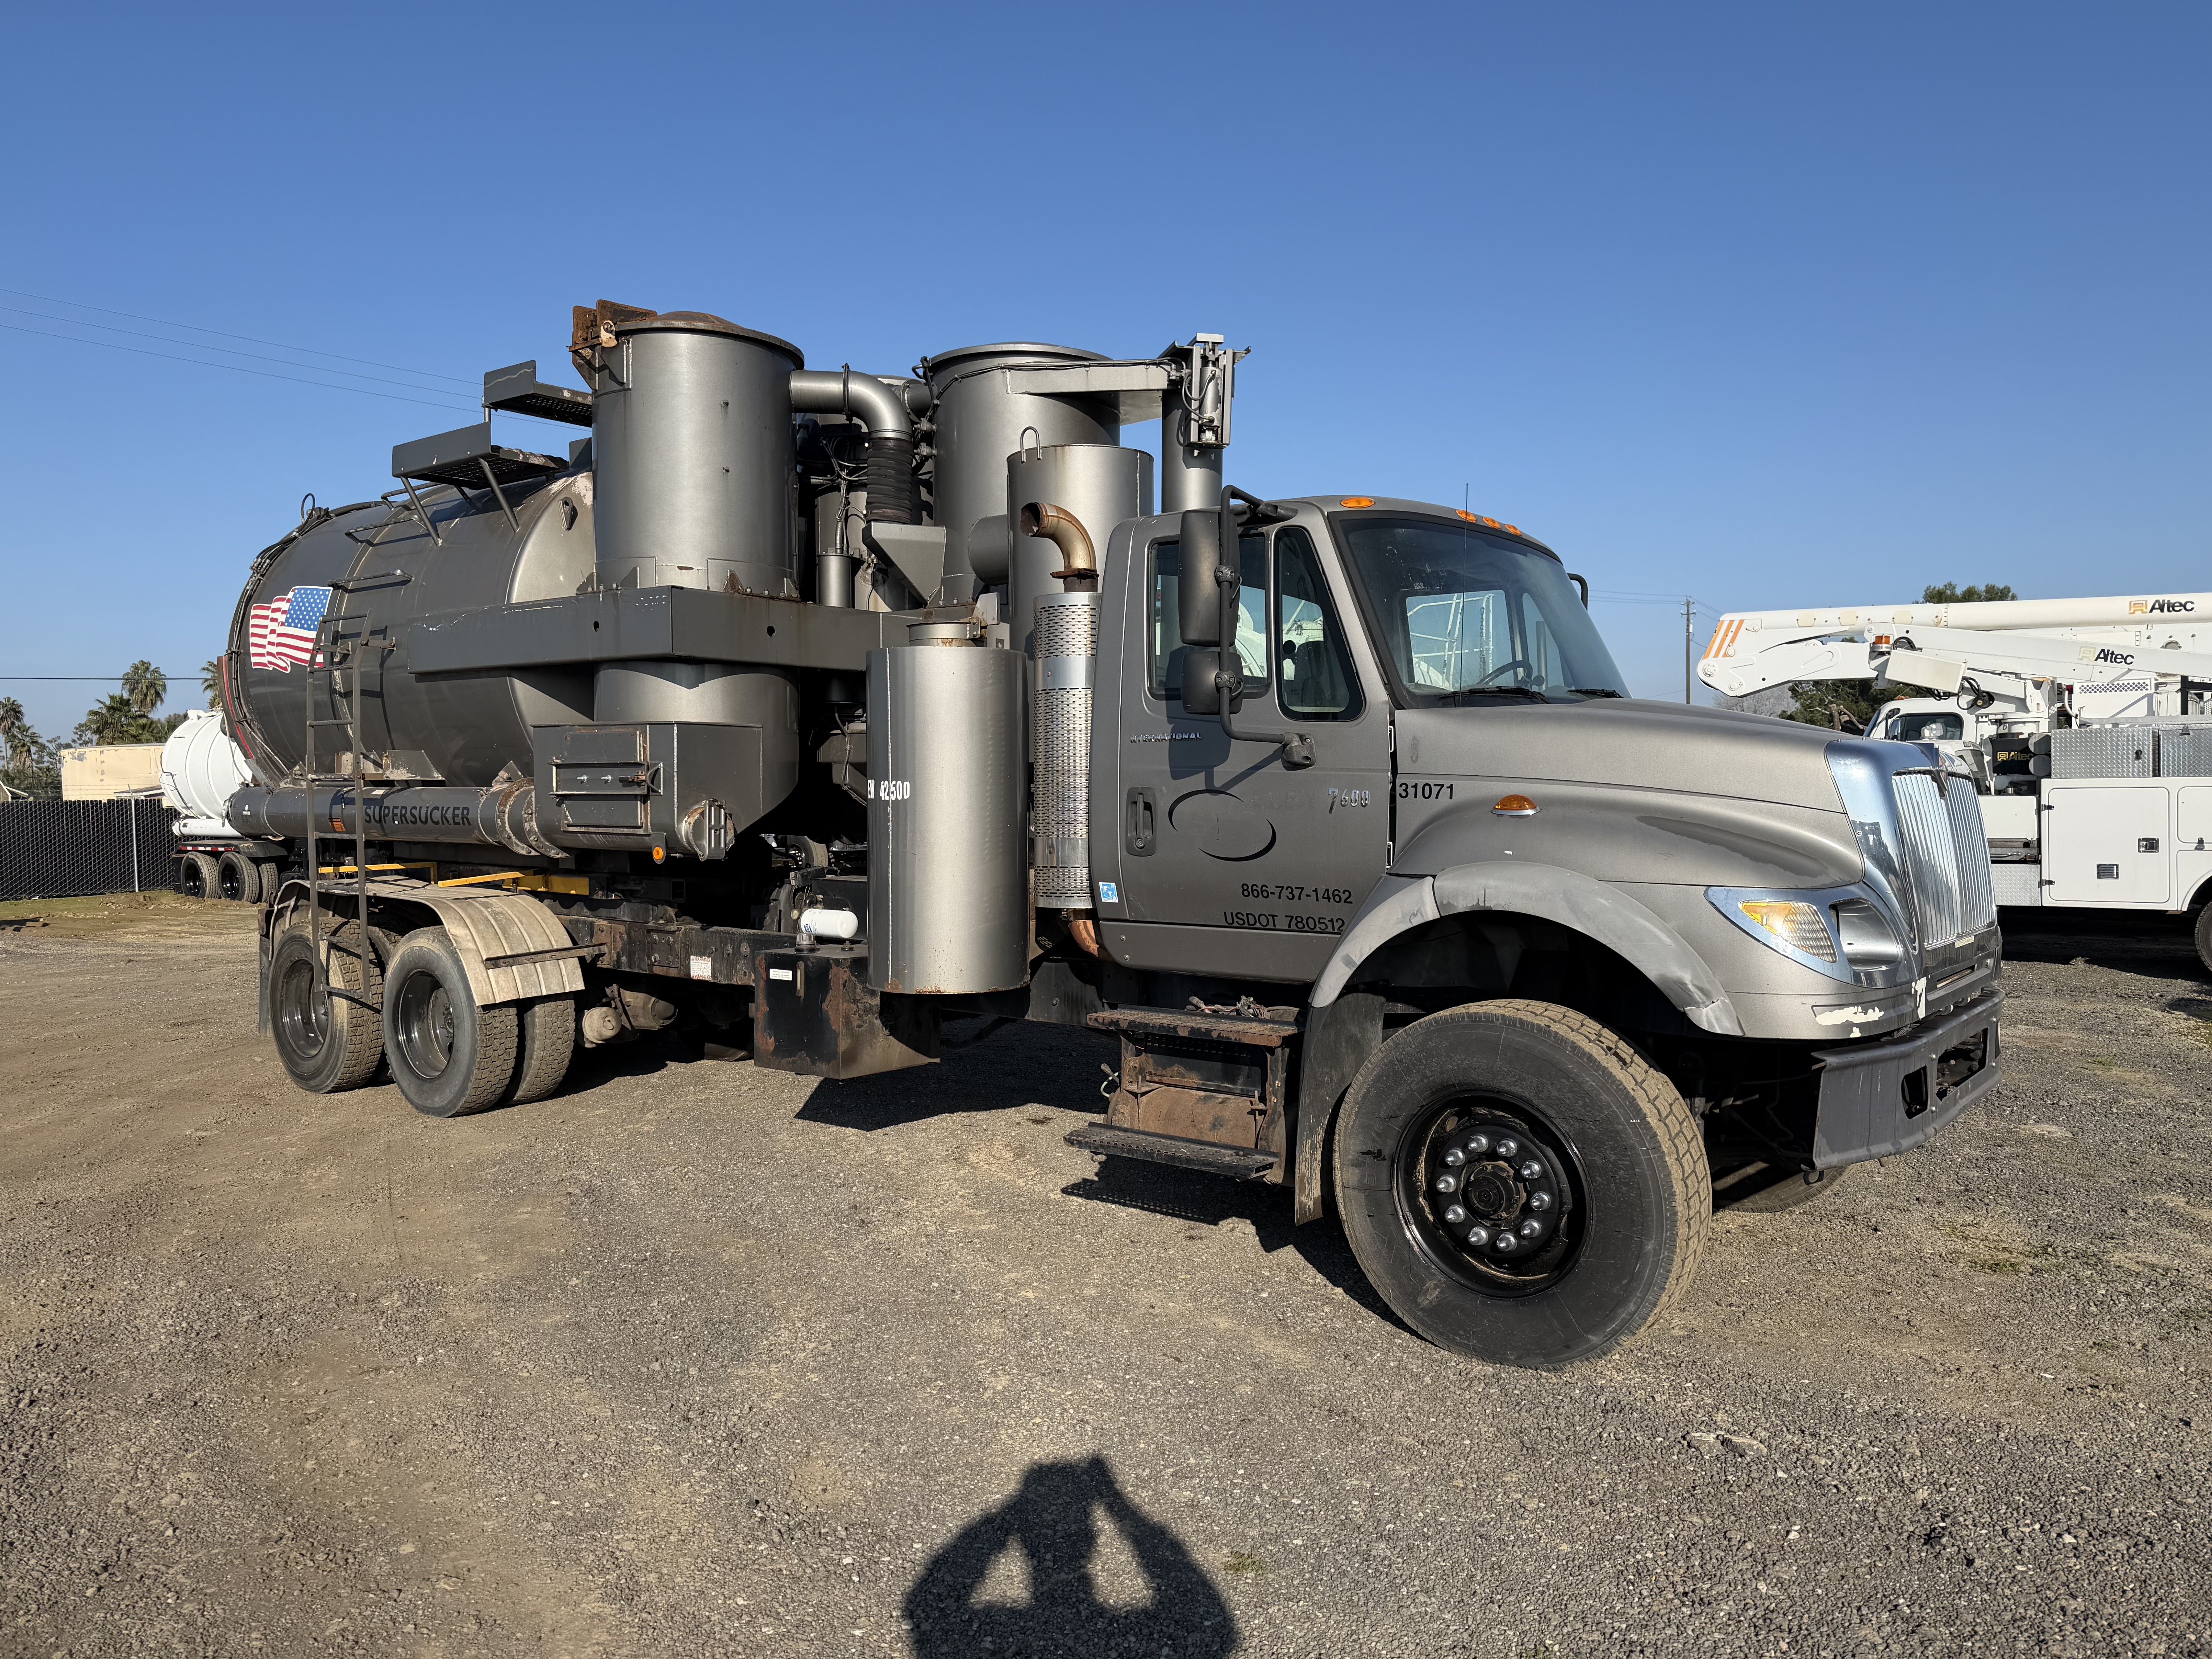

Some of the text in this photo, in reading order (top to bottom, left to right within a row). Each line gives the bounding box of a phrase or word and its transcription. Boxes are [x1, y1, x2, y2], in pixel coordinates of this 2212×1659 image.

[2149, 599, 2195, 613] Altec
[2094, 648, 2135, 665] Altec
[2008, 751, 2034, 761] Altec
[879, 780, 910, 800] 42500
[1399, 782, 1454, 800] 31071
[1328, 788, 1370, 814] 7600
[364, 805, 472, 826] SUPERSUCKER
[1241, 883, 1353, 904] 866-737-1462
[1223, 911, 1345, 933] USDOT 780512
